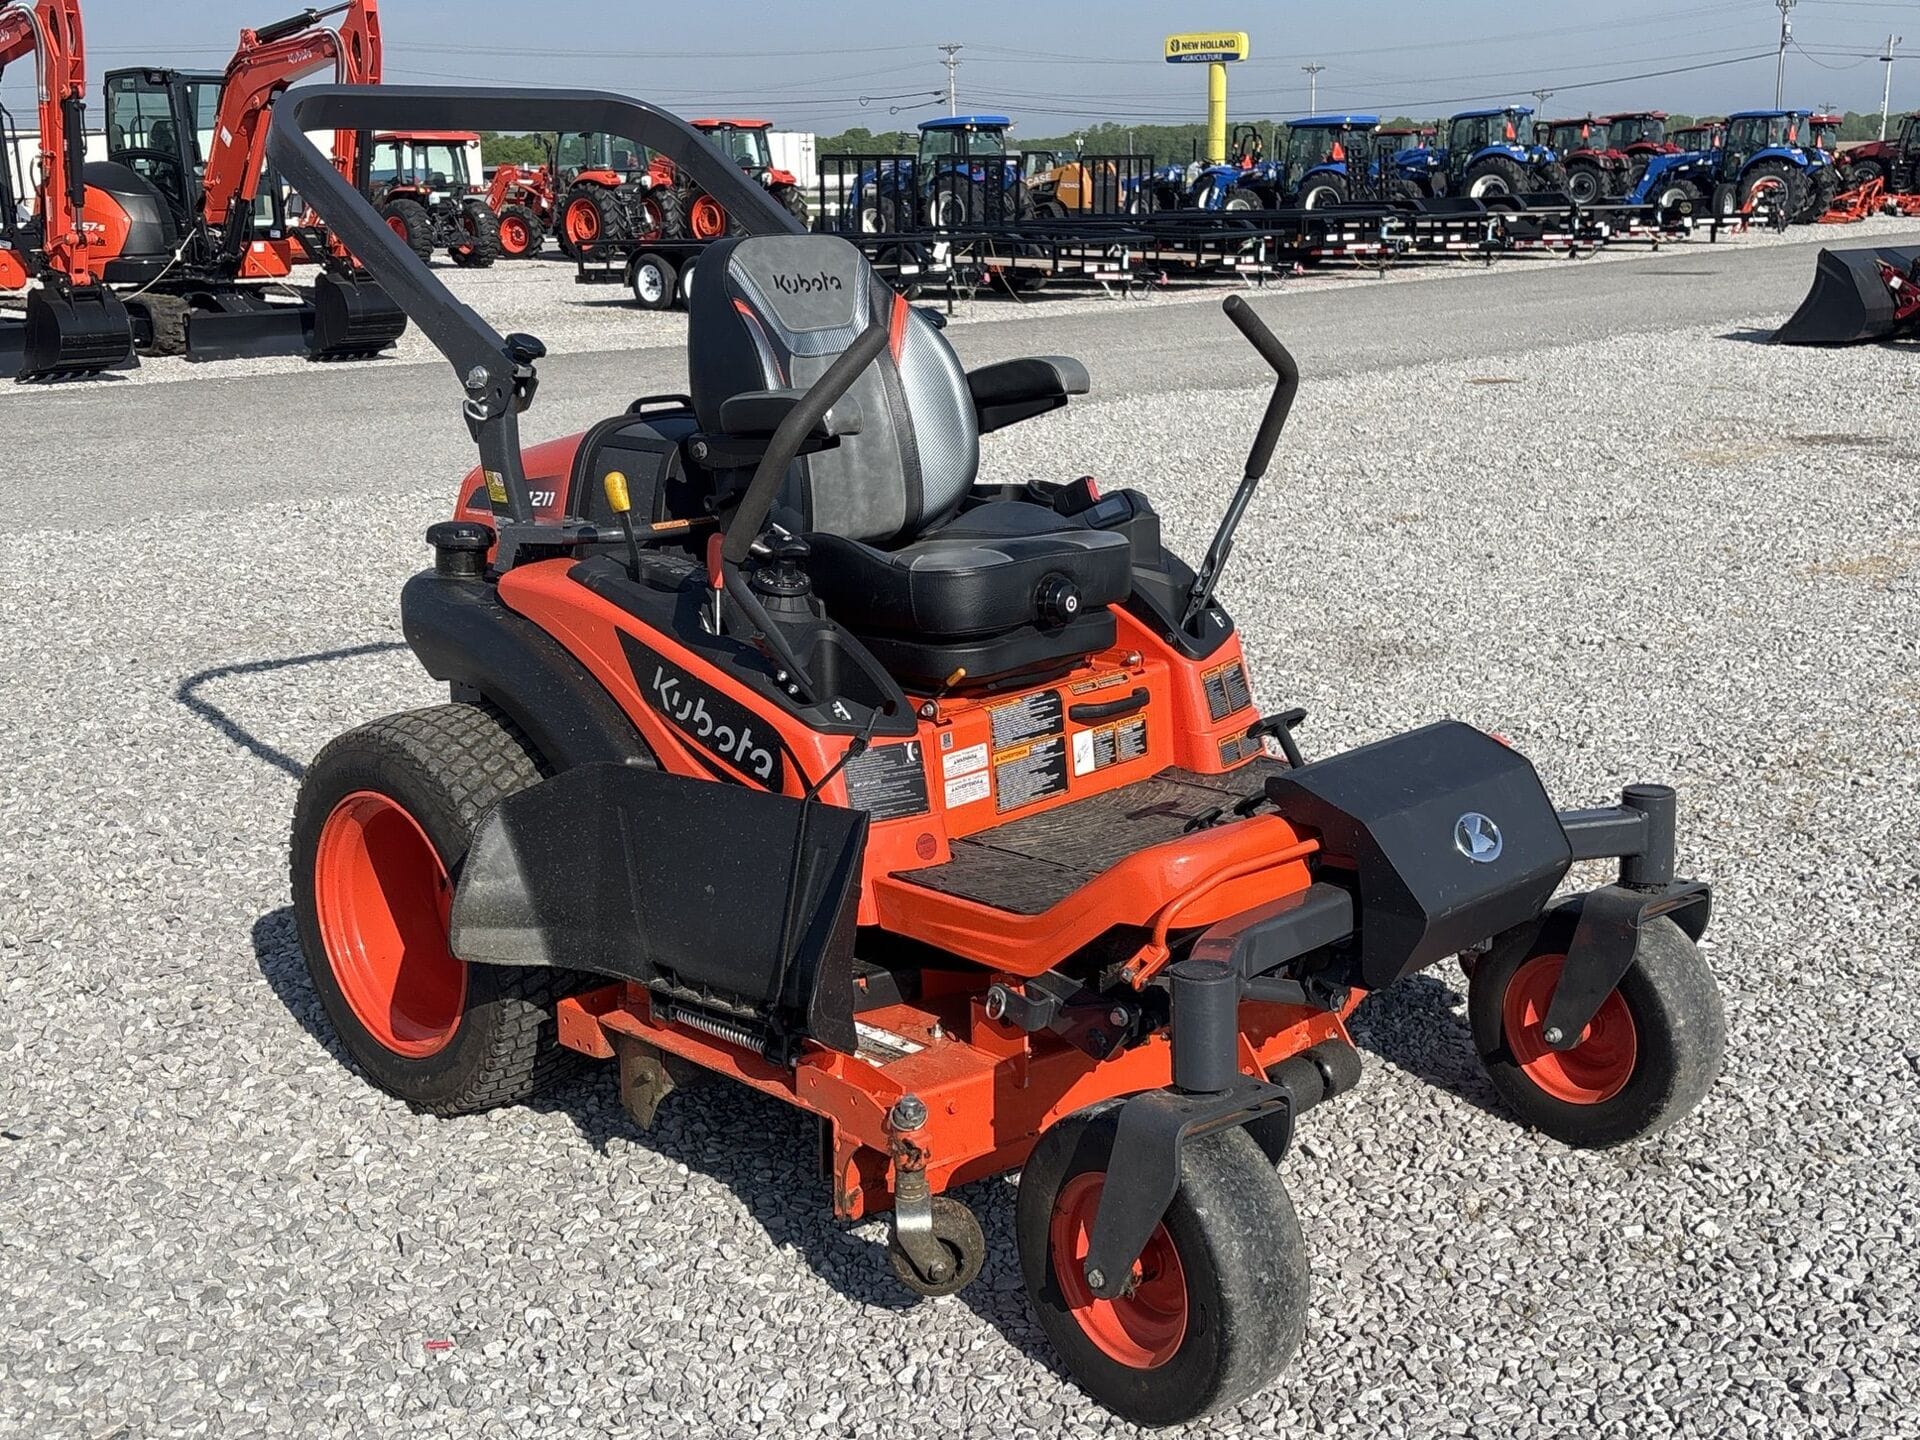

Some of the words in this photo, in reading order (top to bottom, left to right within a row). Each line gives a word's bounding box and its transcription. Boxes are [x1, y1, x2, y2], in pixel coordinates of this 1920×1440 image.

[1181, 41, 1200, 51] NEW
[1200, 39, 1235, 49] HOLLAND
[1181, 53, 1223, 61] AGRICULTURE
[1026, 172, 1052, 187] CASE
[772, 271, 842, 294] Kubota
[653, 665, 773, 779] Kubota
